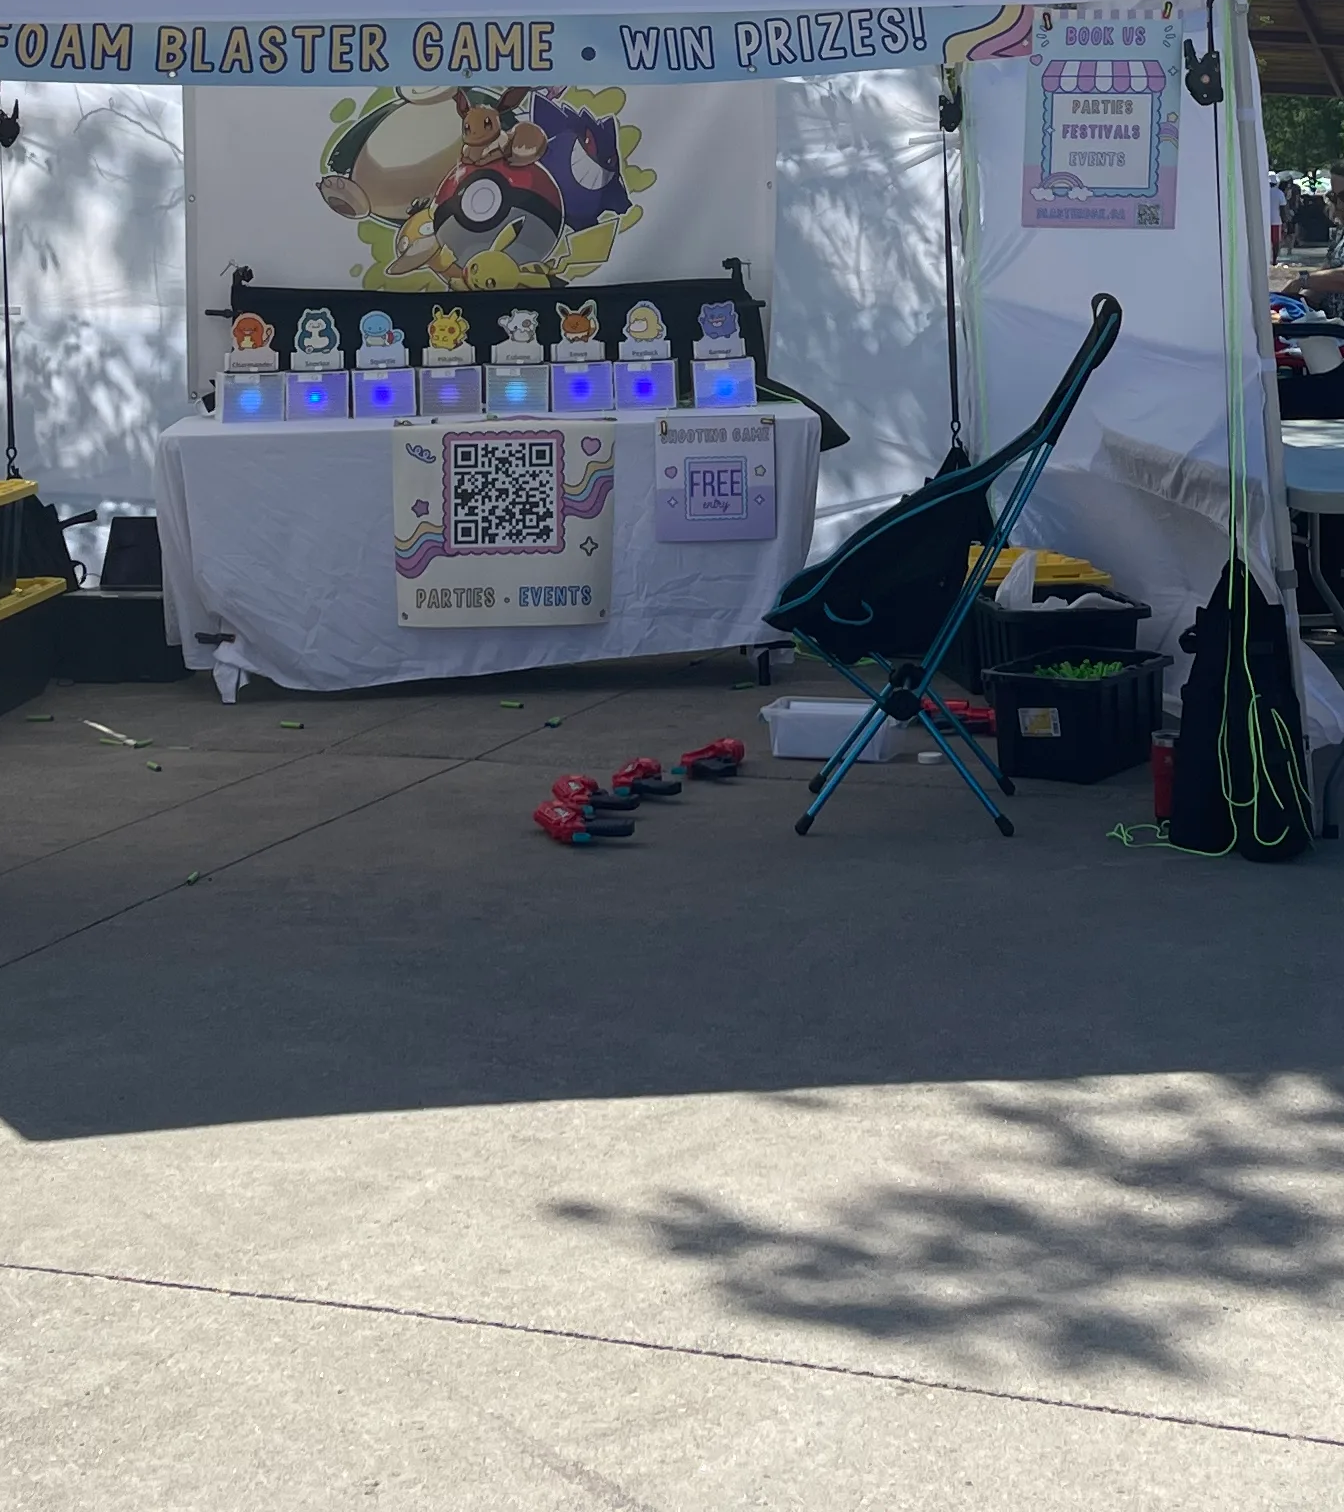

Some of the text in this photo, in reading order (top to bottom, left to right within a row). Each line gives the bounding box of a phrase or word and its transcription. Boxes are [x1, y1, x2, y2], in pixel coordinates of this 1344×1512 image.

[155, 24, 390, 74] BLASTER
[412, 21, 555, 72] GAME
[619, 24, 716, 71] WIN
[734, 7, 927, 67] PRIZES!
[1065, 25, 1146, 46] BOOK US
[1071, 99, 1134, 115] PARTIES
[1061, 124, 1141, 140] FESTIVALS
[1068, 151, 1126, 167] EVENTS
[731, 426, 770, 442] GAME
[690, 469, 743, 497] FREE
[702, 498, 731, 513] entry
[415, 585, 592, 609] PARTIES EVENTS
